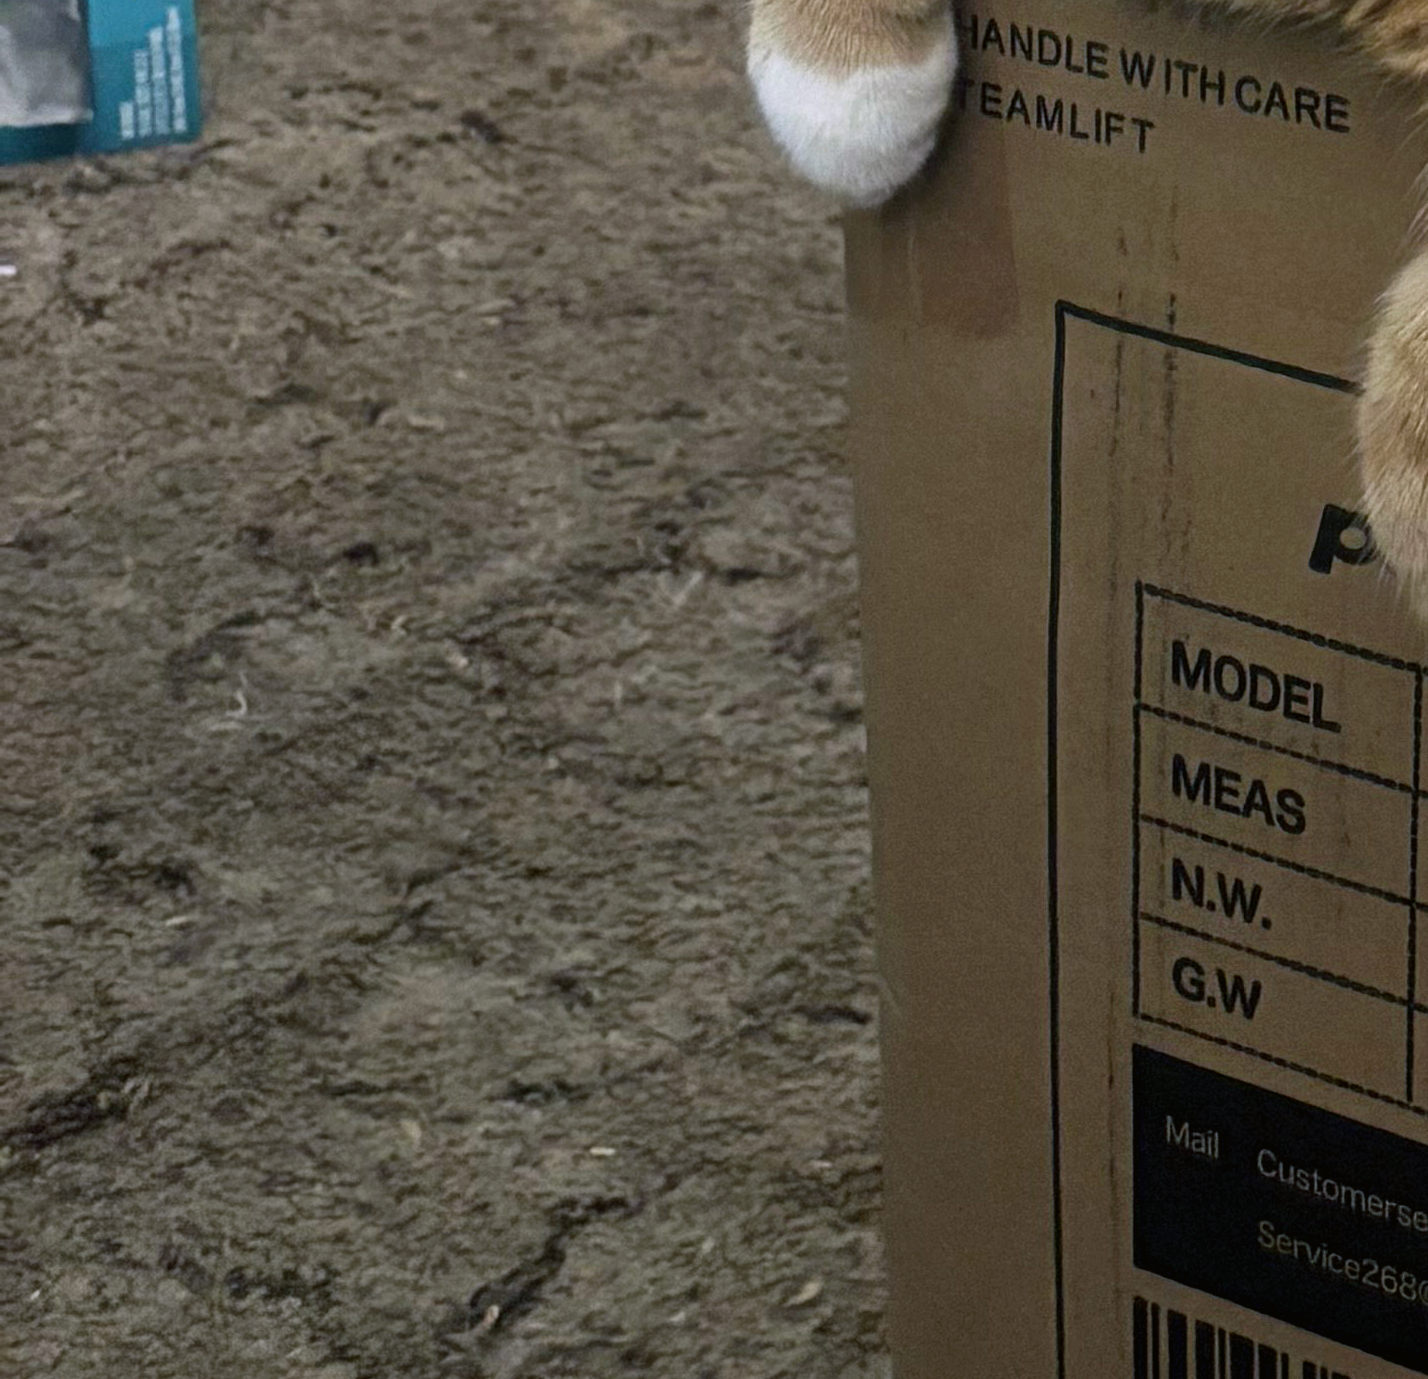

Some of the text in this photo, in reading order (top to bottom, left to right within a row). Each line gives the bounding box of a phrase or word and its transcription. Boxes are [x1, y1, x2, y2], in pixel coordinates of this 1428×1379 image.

[1120, 46, 1226, 107] WITH
[1234, 74, 1352, 134] CARE
[1171, 639, 1342, 734] MODEL
[1171, 753, 1307, 835] MEAS
[1171, 857, 1273, 930] N.W.
[1171, 956, 1263, 1021] G.W
[1165, 1114, 1220, 1159] Mail
